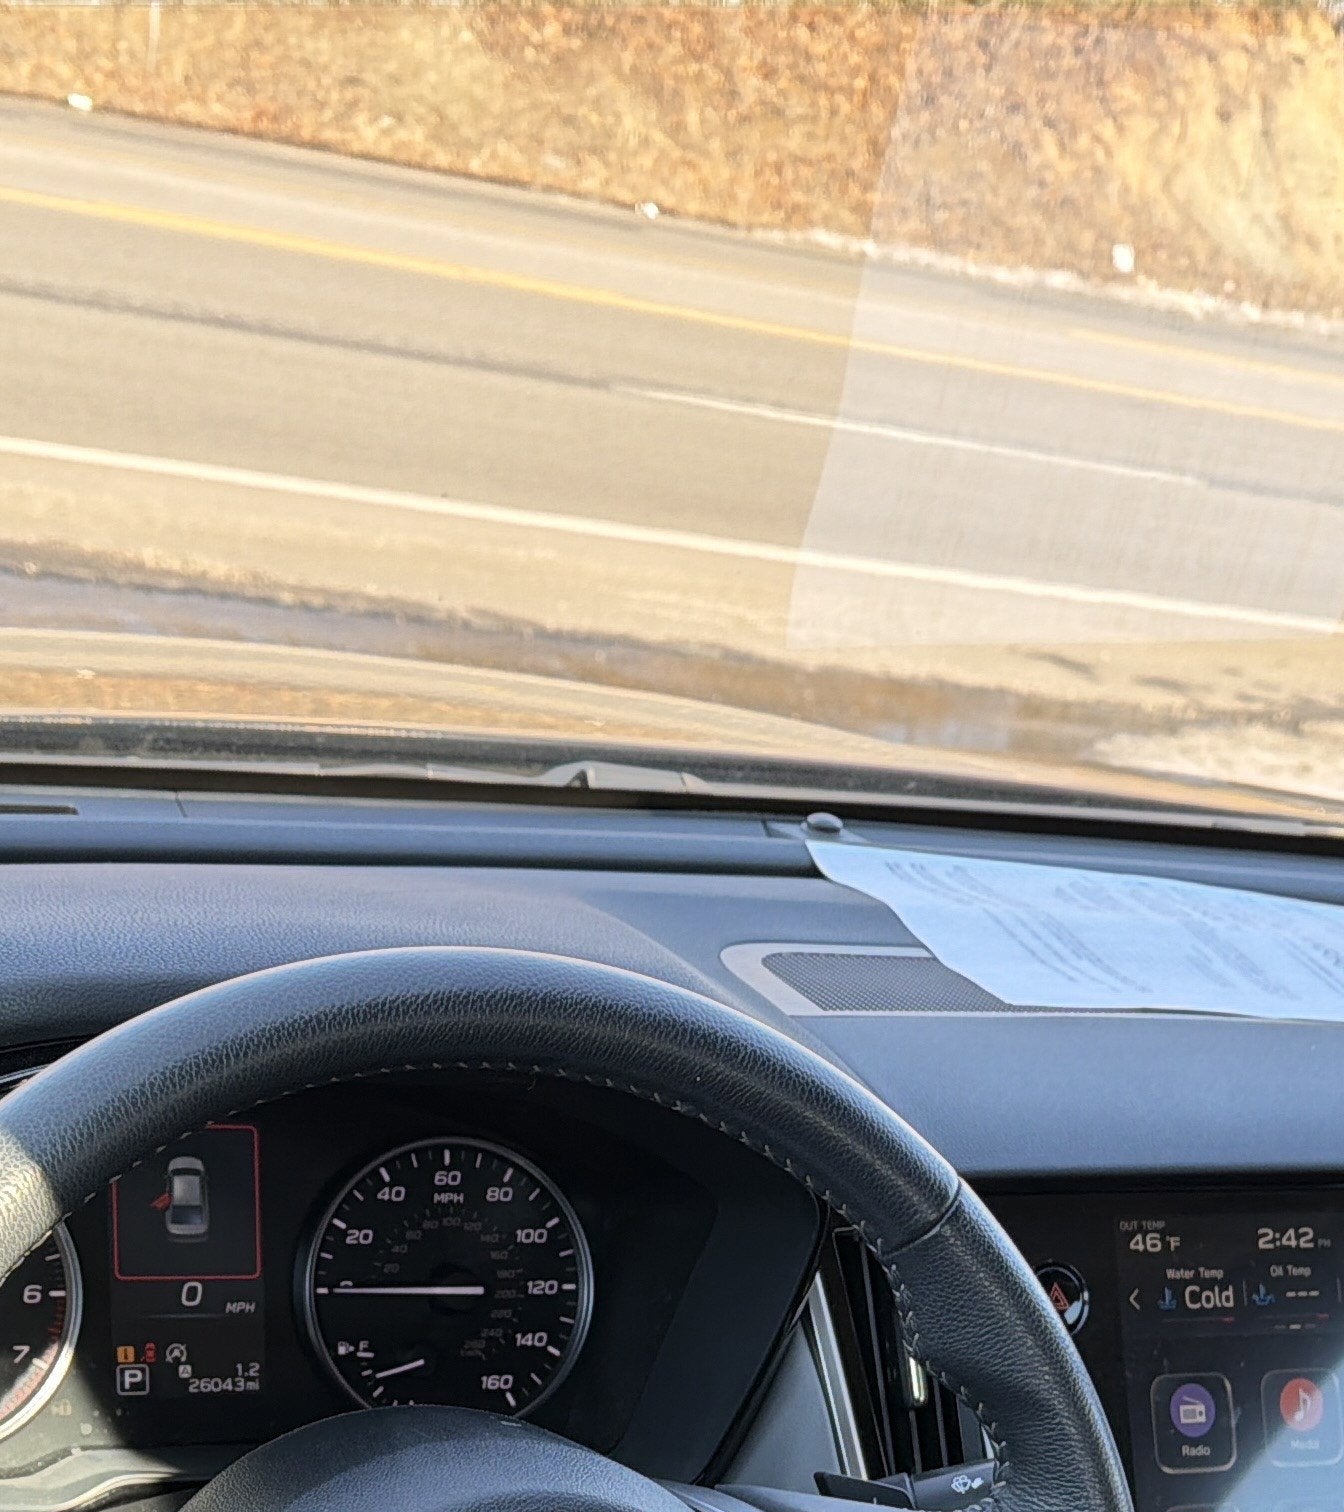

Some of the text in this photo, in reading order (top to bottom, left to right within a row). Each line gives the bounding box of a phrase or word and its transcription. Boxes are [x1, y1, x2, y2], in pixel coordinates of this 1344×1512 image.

[434, 1171, 461, 1186] 60
[377, 1186, 406, 1201] 40
[434, 1192, 464, 1204] MPH
[486, 1187, 512, 1202] 80
[346, 1229, 373, 1245] 20
[516, 1228, 548, 1244] 100
[1129, 1233, 1161, 1252] 46
[1257, 1227, 1314, 1249] 2:42
[1166, 1267, 1224, 1280] Water Temp
[1270, 1265, 1312, 1278] Oil Temp
[23, 1284, 42, 1304] 6
[181, 1281, 203, 1307] 0
[527, 1280, 558, 1295] 120
[1184, 1284, 1235, 1310] Cold
[225, 1302, 256, 1314] MPH
[515, 1332, 548, 1347] 140
[13, 1345, 30, 1363] 7
[235, 1362, 260, 1377] 1.2
[124, 1369, 143, 1390] P
[481, 1374, 514, 1390] 160
[1181, 1444, 1211, 1457] Radio
